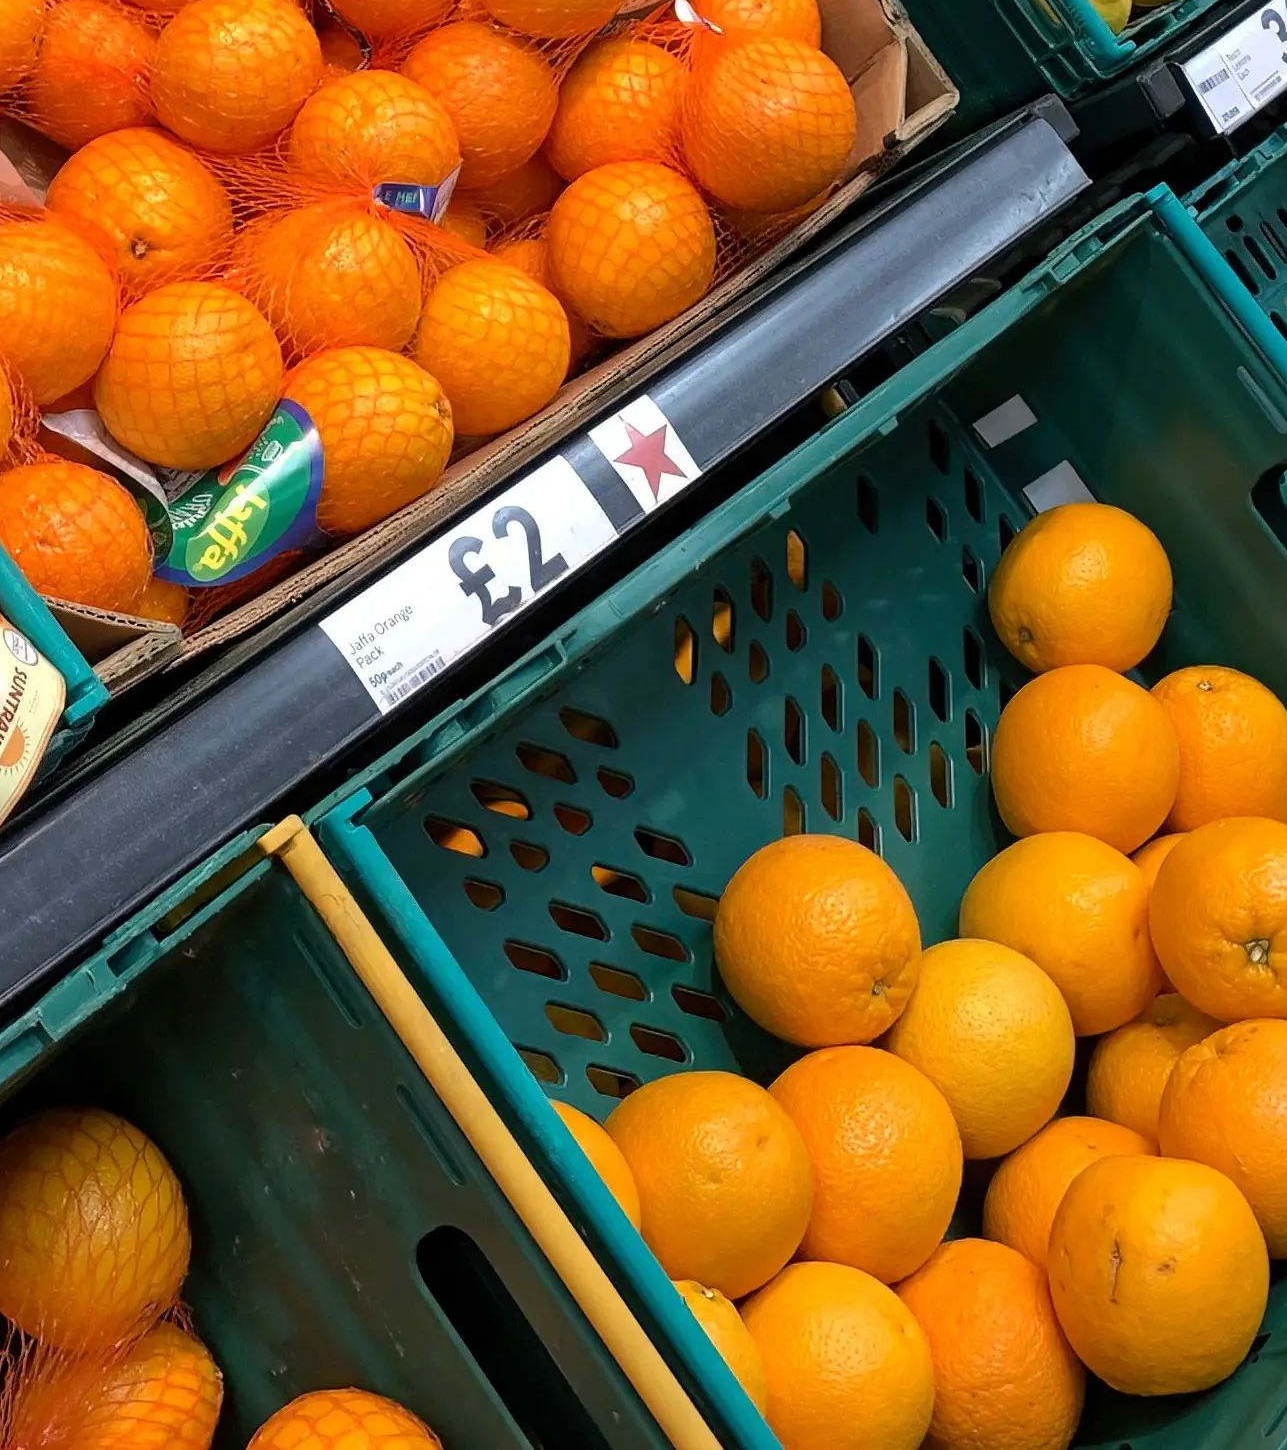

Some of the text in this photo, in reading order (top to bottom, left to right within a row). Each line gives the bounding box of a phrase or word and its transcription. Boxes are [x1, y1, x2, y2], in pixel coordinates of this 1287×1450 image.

[447, 505, 570, 628] £2
[349, 603, 415, 656] Jaffa Orange
[355, 644, 386, 670] Pack
